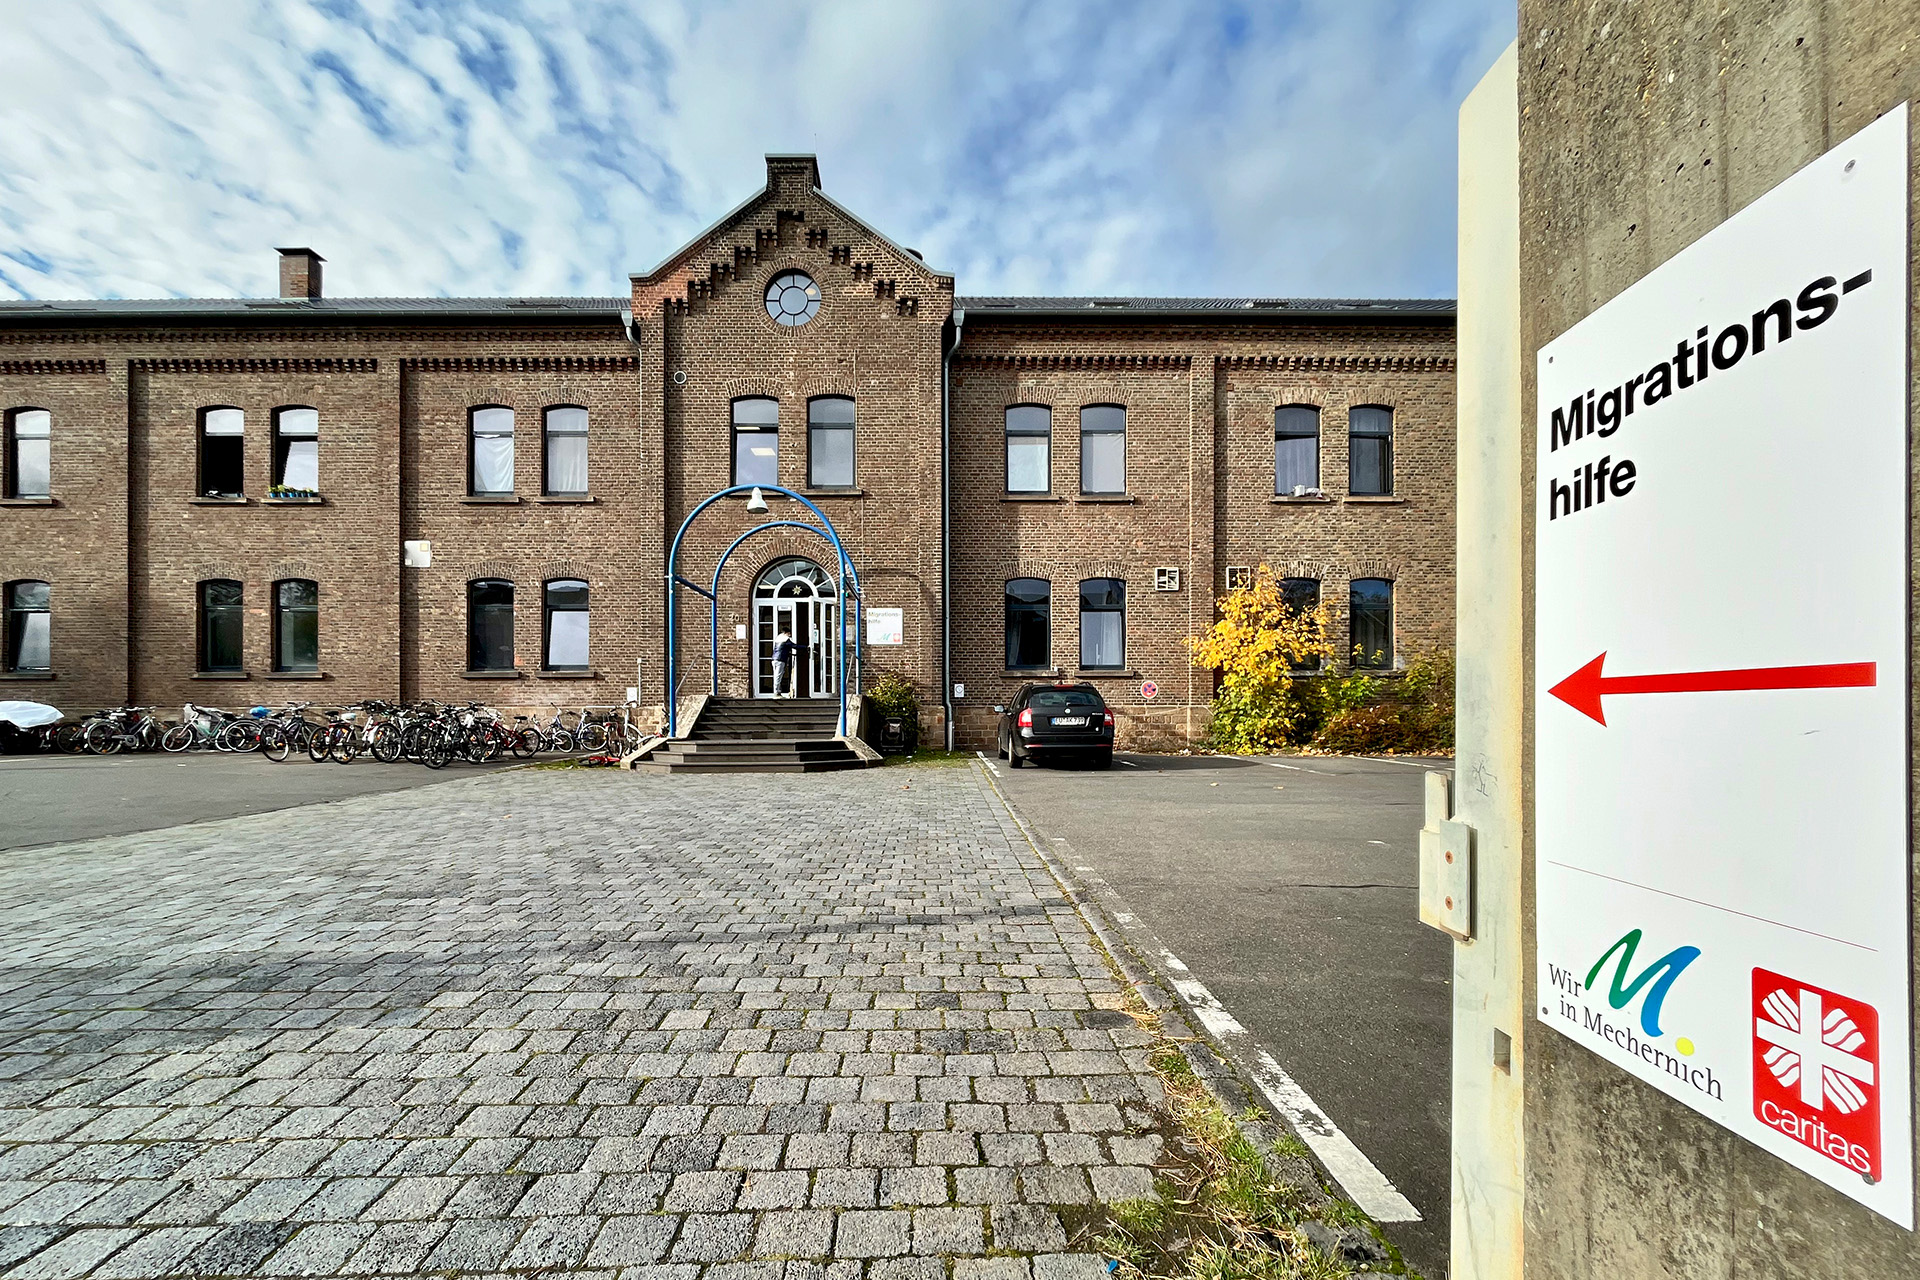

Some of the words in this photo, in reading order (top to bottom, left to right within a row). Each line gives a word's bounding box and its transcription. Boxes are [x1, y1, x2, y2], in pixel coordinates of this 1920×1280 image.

[1550, 268, 1872, 453] Migrations-
[1549, 455, 1637, 521] hilfe
[1548, 963, 1582, 998] Wir
[1560, 994, 1578, 1023] in
[1583, 1005, 1724, 1102] Mechernich
[1761, 1100, 1871, 1173] caritas
